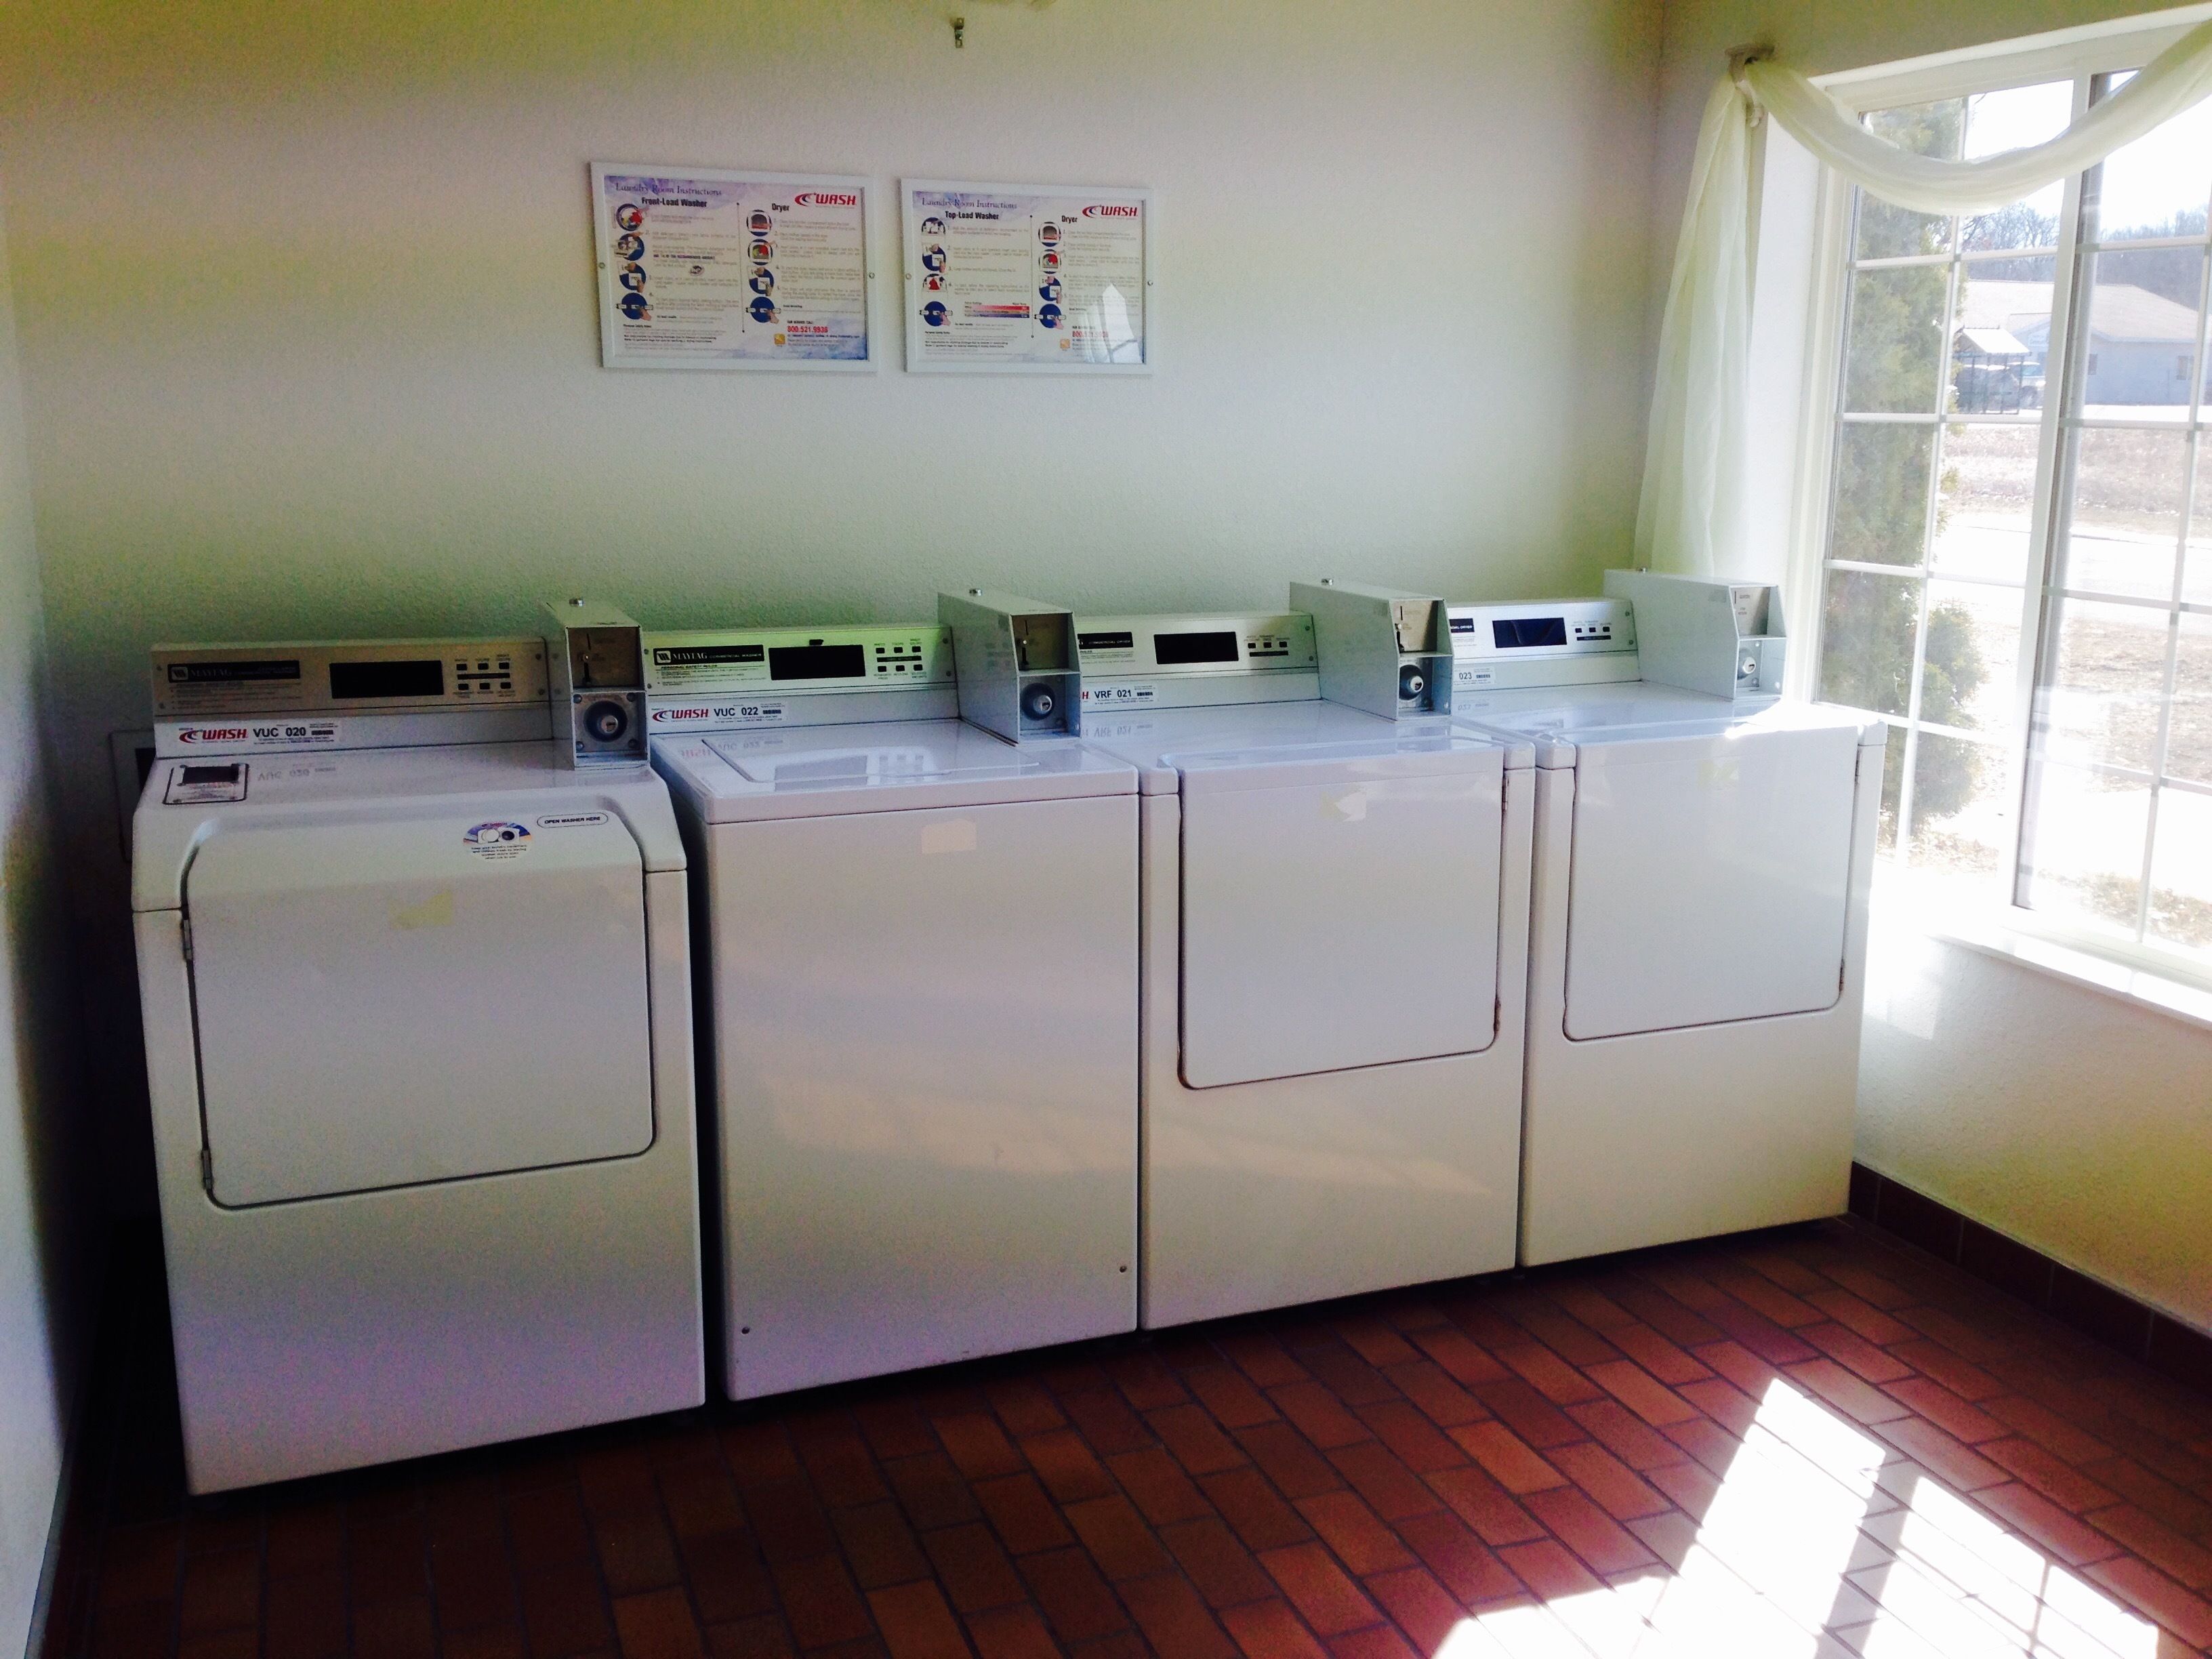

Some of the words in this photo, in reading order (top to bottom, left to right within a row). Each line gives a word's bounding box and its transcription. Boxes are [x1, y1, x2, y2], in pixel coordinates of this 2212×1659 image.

[616, 183, 648, 194] Laundry
[652, 184, 674, 194] Room
[677, 186, 722, 195] Instructions
[641, 197, 679, 206] Front-Load
[681, 199, 708, 207] Washer
[815, 194, 857, 205] WASH
[922, 198, 950, 207] Laundry
[977, 200, 1017, 209] Instructions
[771, 203, 790, 212] Dryer
[1101, 206, 1137, 216] WASH
[975, 211, 999, 220] Washer
[1061, 216, 1078, 224] Dryer
[1458, 672, 1472, 680] 023
[1094, 690, 1112, 699] VRF
[1117, 689, 1132, 697] 021
[672, 709, 709, 719] WASH
[714, 708, 735, 717] VUC
[741, 707, 759, 716] 022
[203, 729, 247, 740] WASH
[253, 727, 279, 737] VUC
[285, 726, 306, 737] 020
